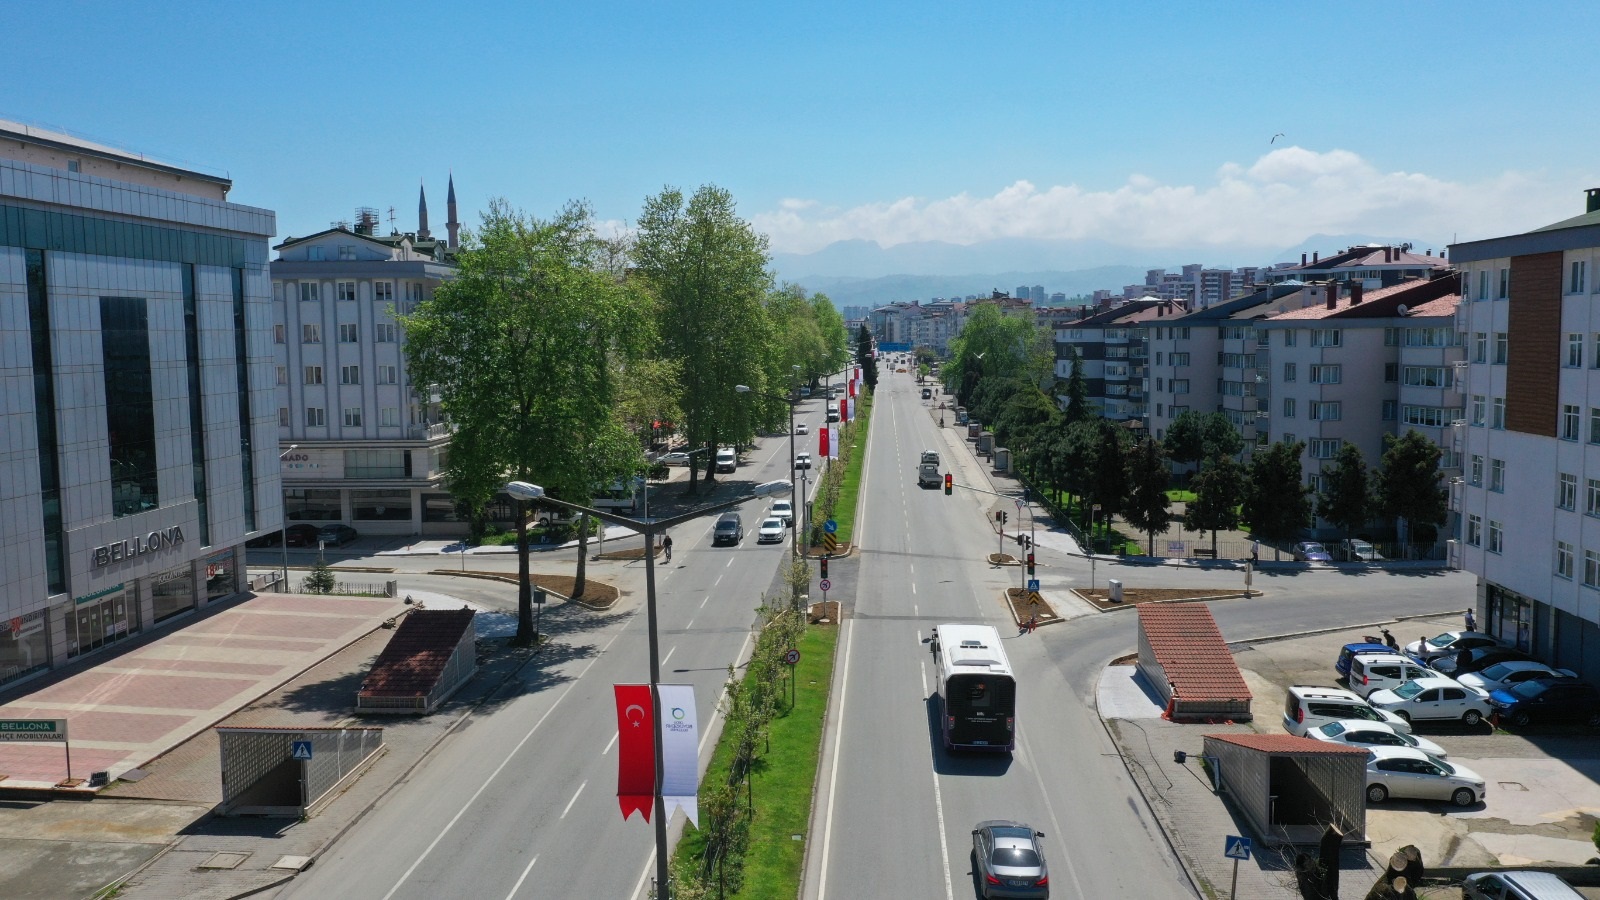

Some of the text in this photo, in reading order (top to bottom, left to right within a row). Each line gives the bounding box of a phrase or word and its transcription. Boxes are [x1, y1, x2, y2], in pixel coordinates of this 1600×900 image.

[93, 526, 184, 568] BELLONA
[1, 722, 51, 730] BELLONA
[16, 731, 64, 740] MOBİLYALARI
